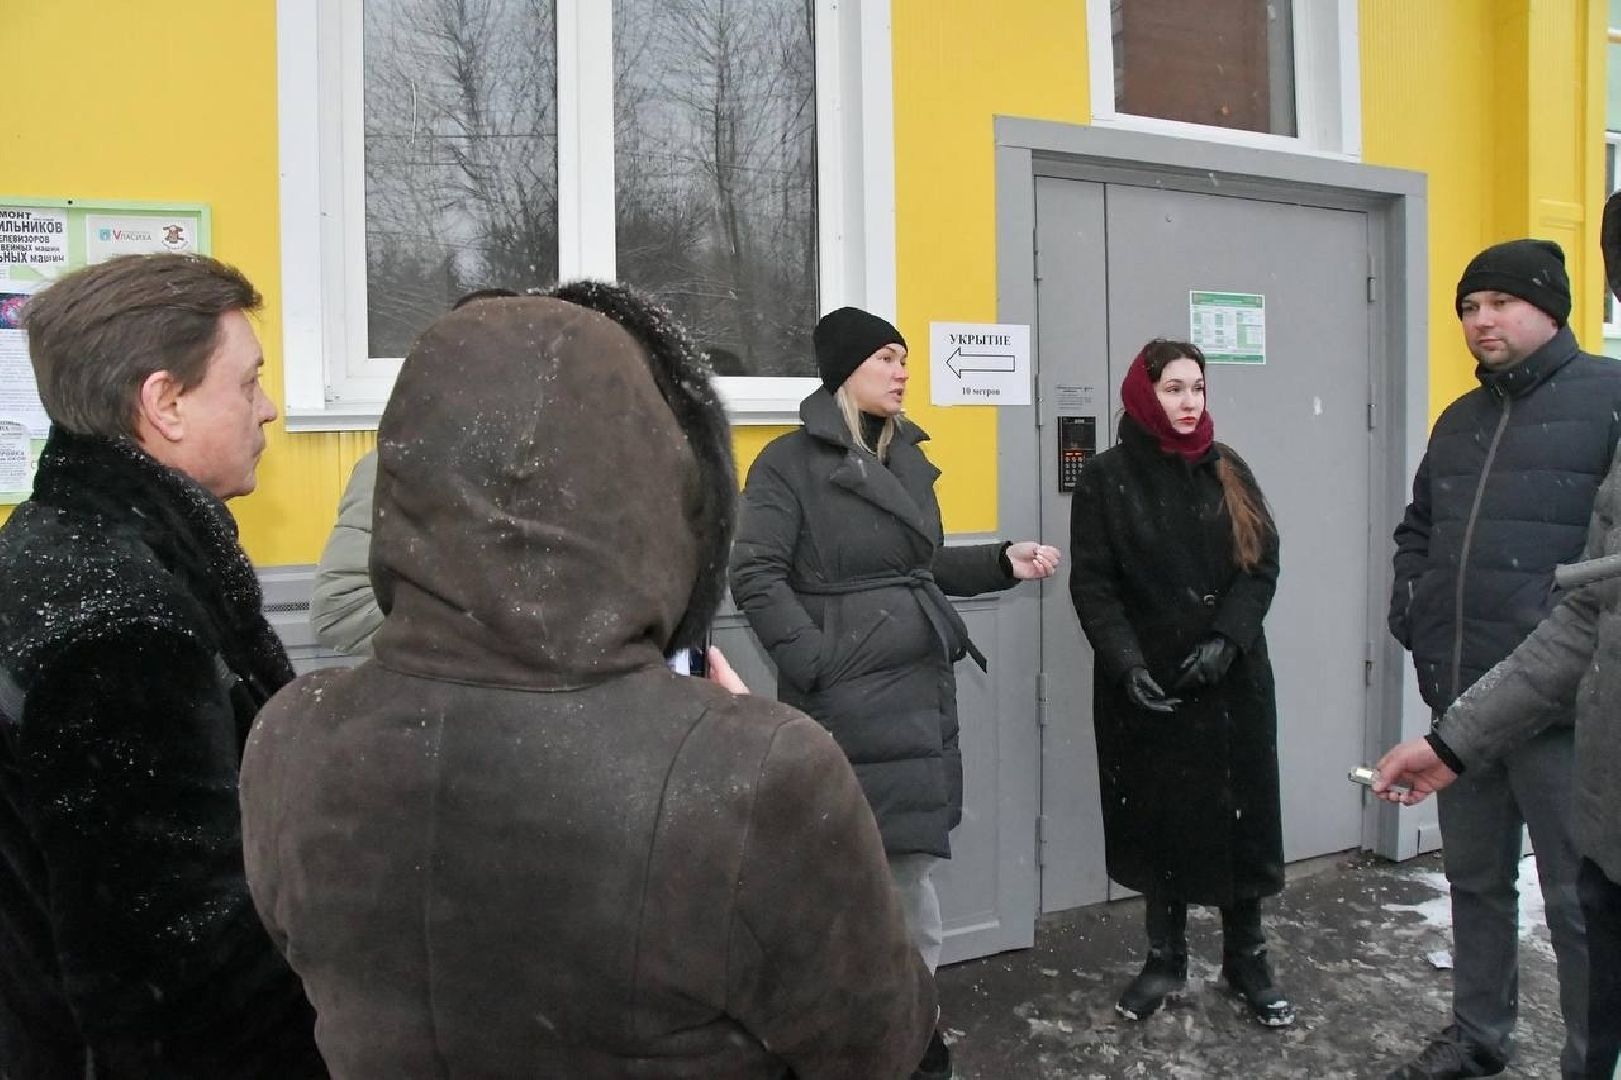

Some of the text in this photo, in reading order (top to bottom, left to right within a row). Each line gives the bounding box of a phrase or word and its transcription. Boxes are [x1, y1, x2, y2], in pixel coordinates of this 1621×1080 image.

[950, 334, 1011, 346] УКРЫТИЕ
[962, 387, 1001, 397] 10 метров
